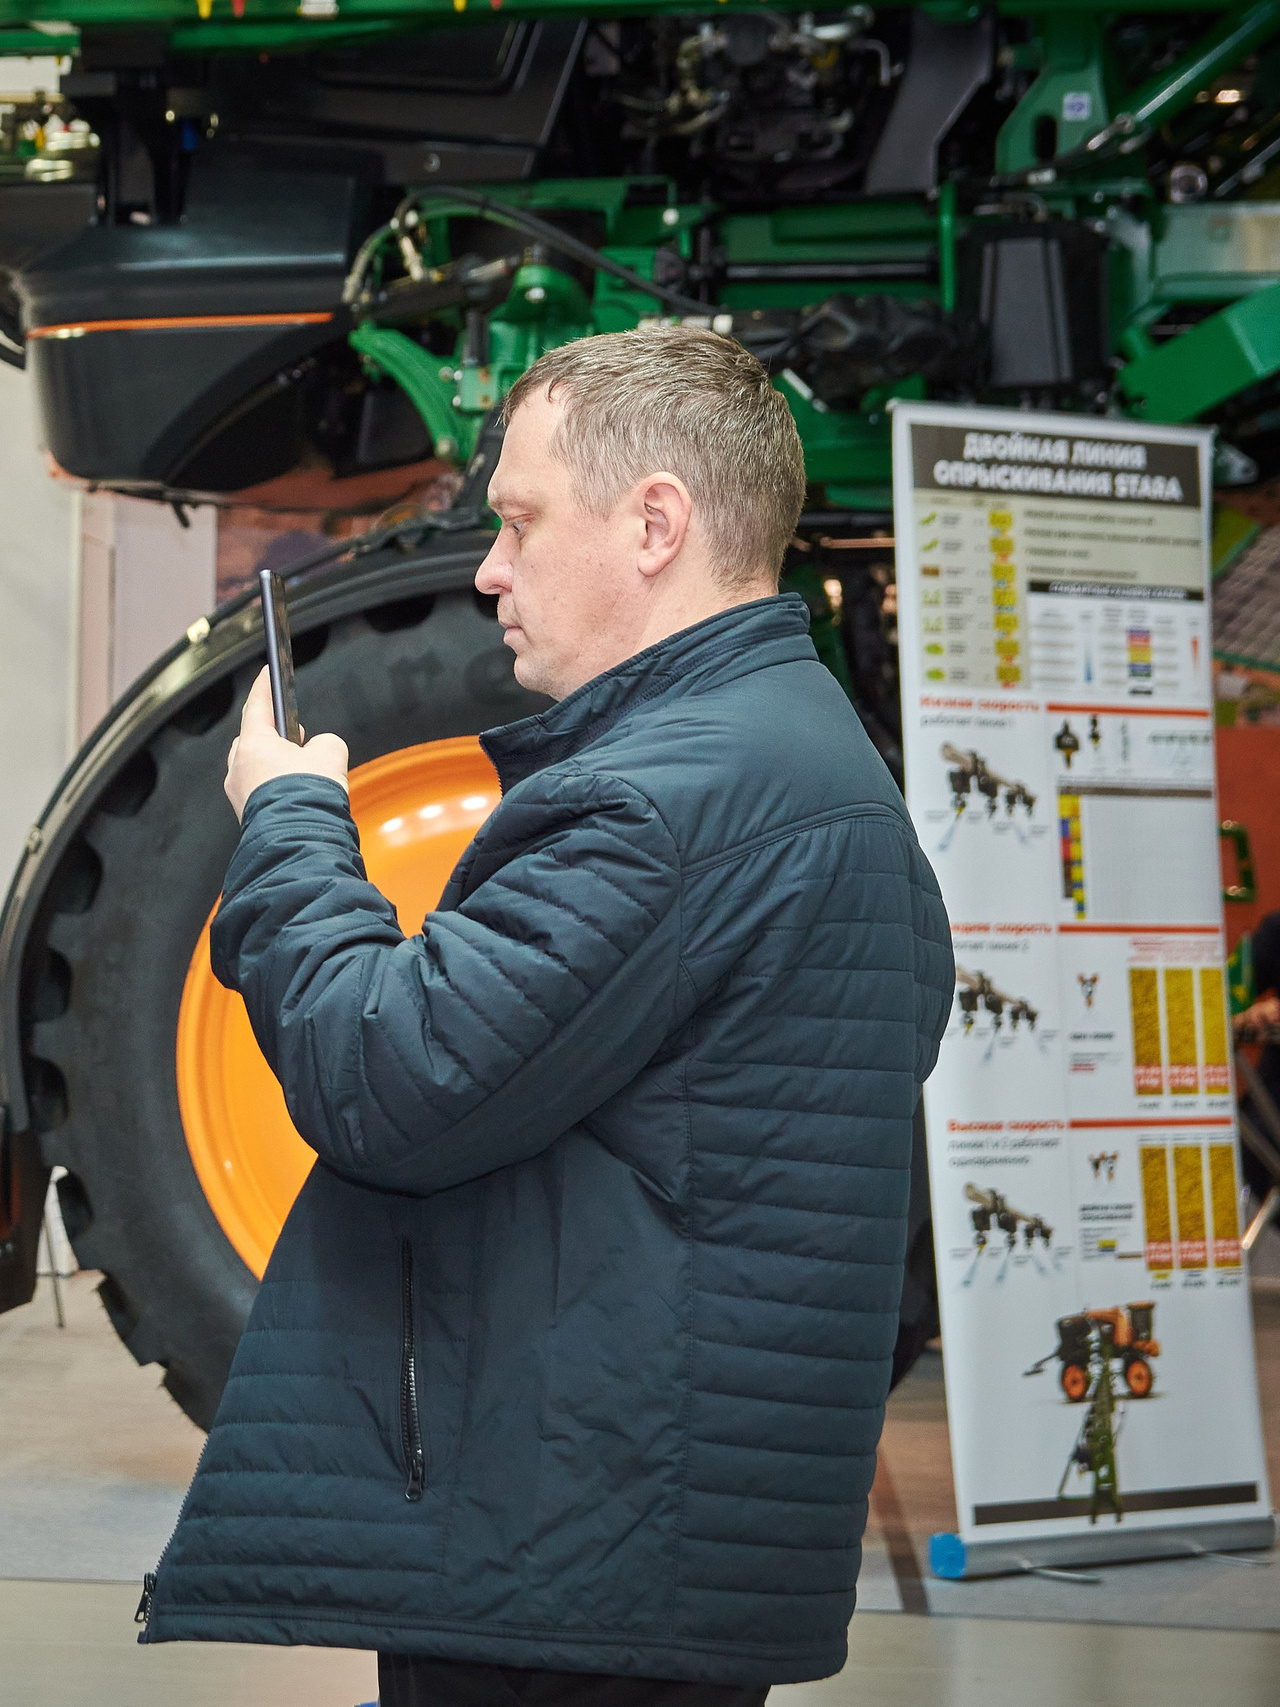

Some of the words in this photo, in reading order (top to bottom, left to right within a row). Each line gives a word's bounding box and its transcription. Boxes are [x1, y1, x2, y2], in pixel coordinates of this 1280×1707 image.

[963, 431, 1069, 465] ДВОЙНАЯ
[1070, 440, 1147, 470] ЛИНИЯ
[933, 459, 1114, 498] ОПРЫСКИВАНИЯ
[1114, 472, 1184, 502] STARA
[947, 1118, 1004, 1132] Высокая
[1006, 1119, 1065, 1134] скорость
